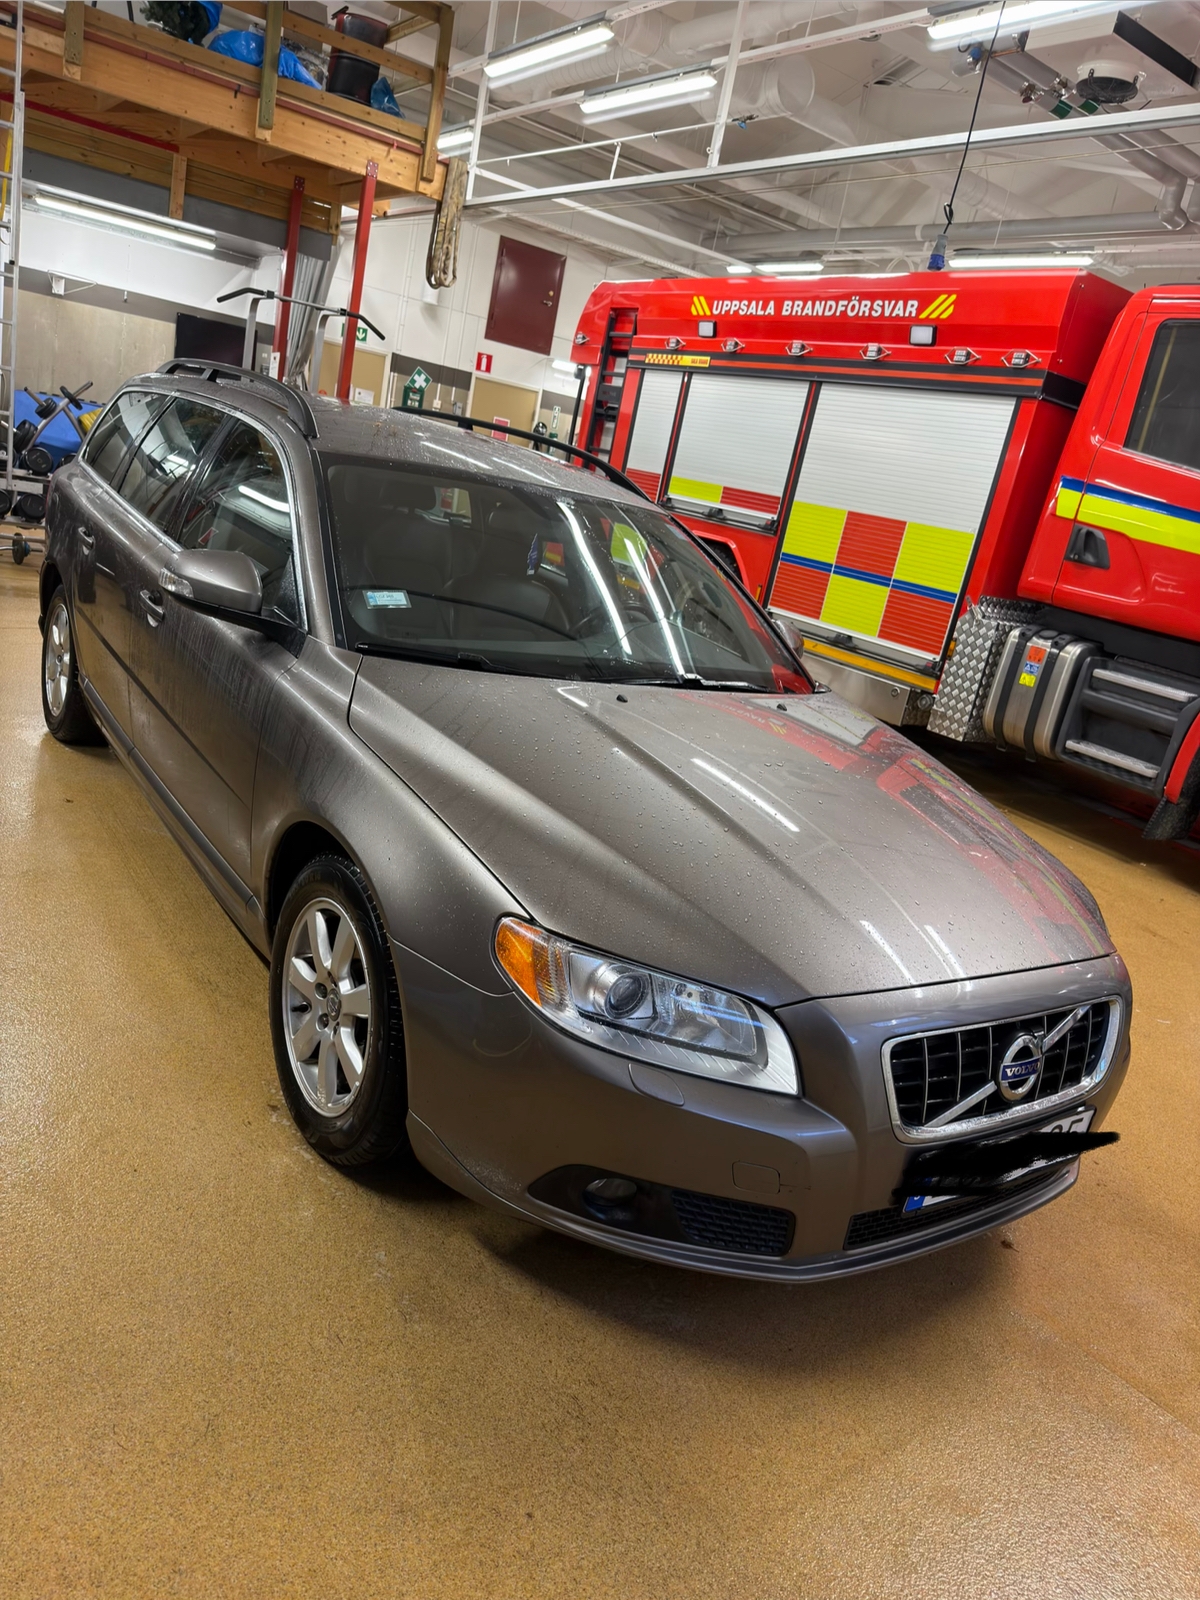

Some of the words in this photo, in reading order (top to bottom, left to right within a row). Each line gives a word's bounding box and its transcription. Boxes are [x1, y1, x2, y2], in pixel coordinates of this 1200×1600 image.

[712, 299, 774, 316] UPPSALA
[782, 296, 918, 318] BRANDFÖRSVAR
[1005, 1061, 1040, 1077] VOLVO
